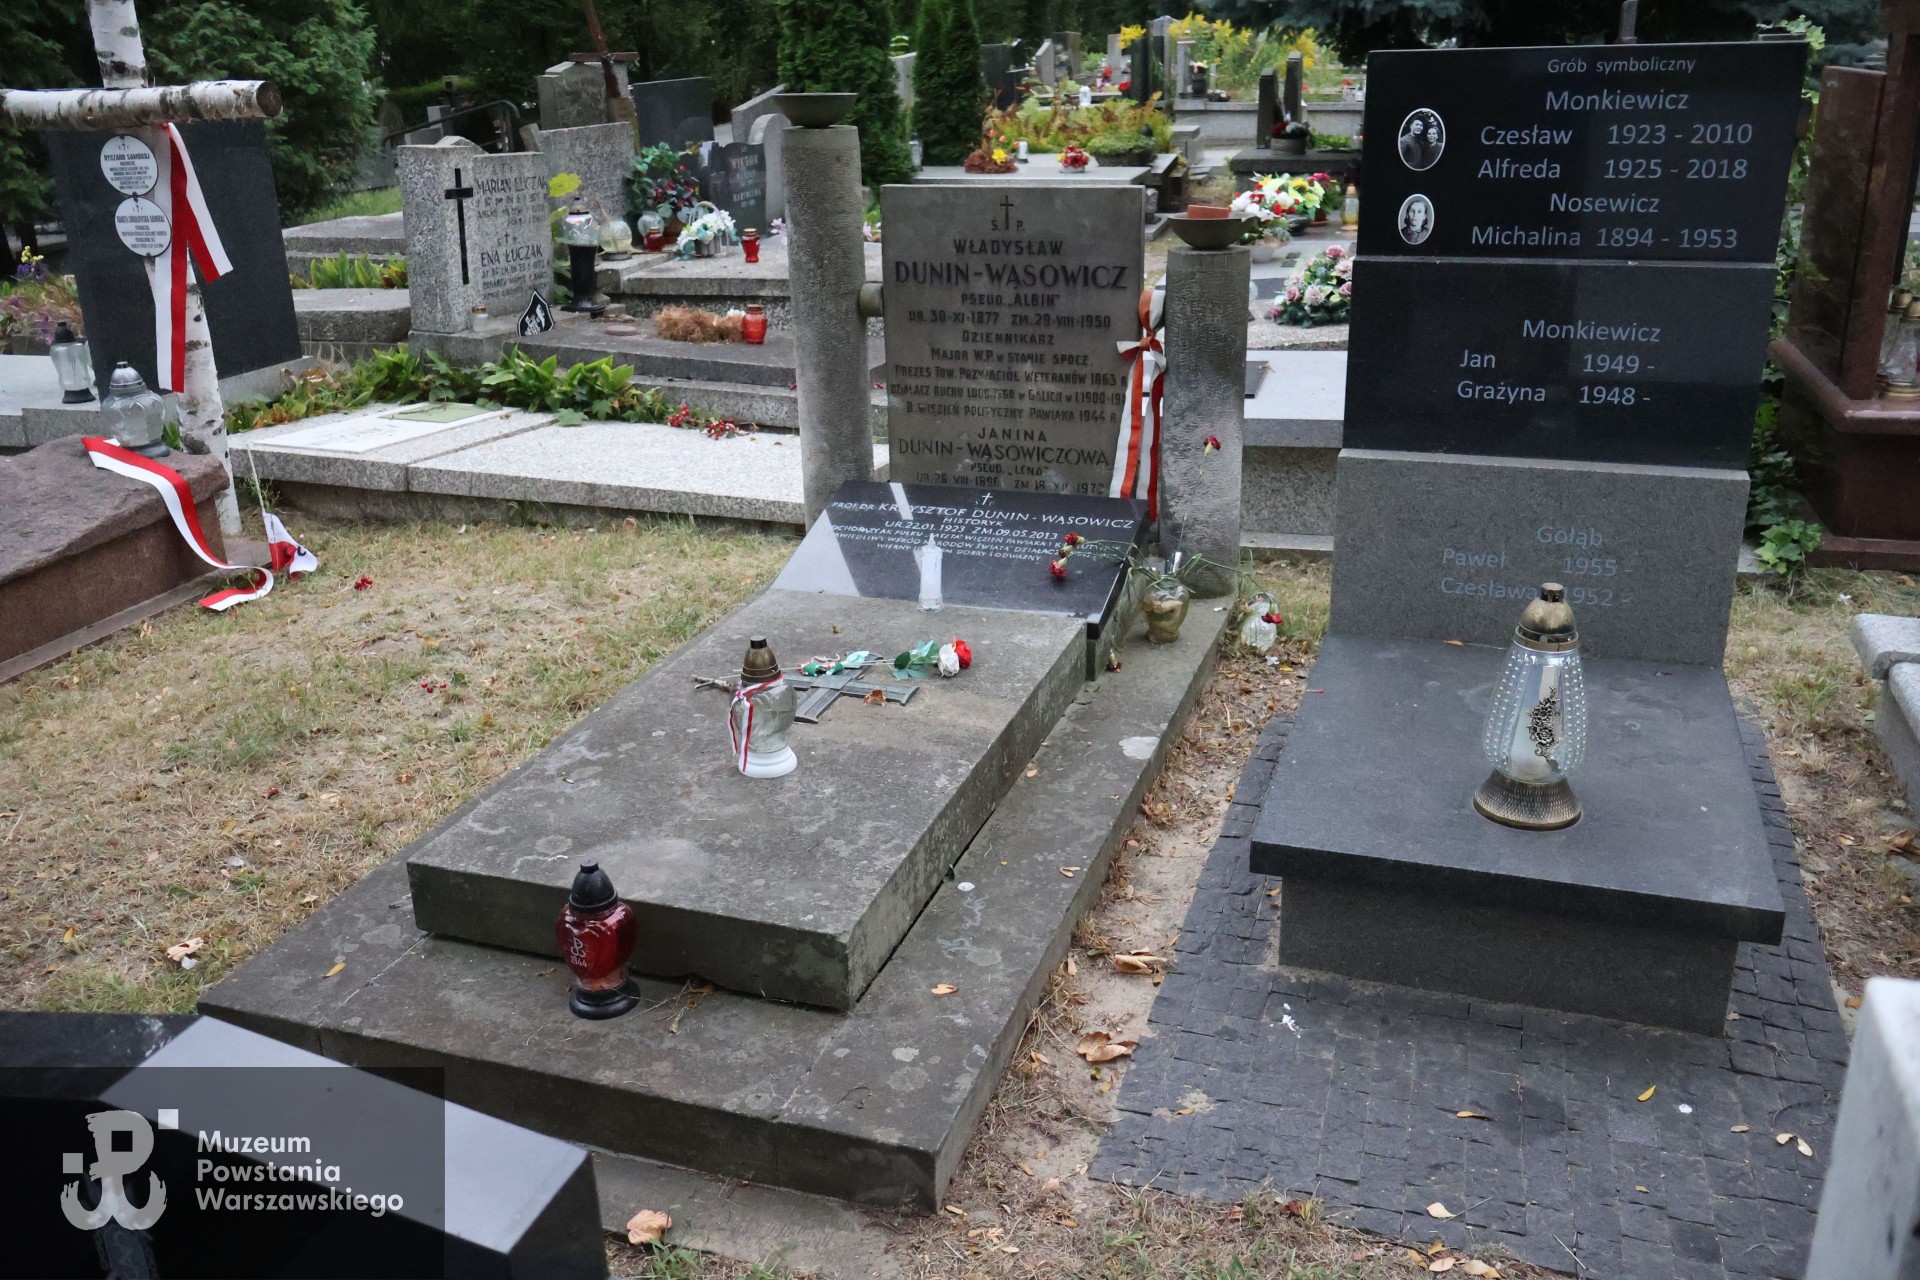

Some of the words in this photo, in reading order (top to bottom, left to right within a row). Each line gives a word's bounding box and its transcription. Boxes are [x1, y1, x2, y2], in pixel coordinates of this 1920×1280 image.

[1547, 57, 1587, 74] Grób
[1596, 57, 1696, 76] symboliczny
[1545, 89, 1690, 112] Monkiewicz
[1480, 125, 1573, 146] Czesław
[1607, 124, 1666, 146] 1923
[1690, 122, 1753, 145] 2010
[1477, 157, 1561, 179] Alfreda
[1604, 158, 1662, 179] 1925
[1686, 157, 1748, 179] 2018
[1549, 192, 1660, 213] Nosewicz
[1471, 225, 1581, 247] Michalina
[1596, 227, 1654, 248] 1894
[1679, 227, 1738, 248] 1953
[954, 239, 1063, 256] WŁADYSŁAW
[962, 330, 1055, 345] DZIENNIKARZ
[1522, 318, 1661, 343] Monkiewicz
[1459, 349, 1496, 368] Jan
[1583, 353, 1640, 374] 1949
[1090, 372, 1117, 386] 1863
[1457, 381, 1546, 405] Grażyna
[1578, 385, 1636, 406] 1948
[1080, 410, 1106, 422] 1944
[978, 428, 1048, 442] JANINA
[879, 502, 967, 516] KRYSZTOF
[972, 509, 1030, 521] DUNIN
[943, 517, 1004, 526] HISTORYK
[923, 540, 974, 549] NRODÓW
[1537, 525, 1603, 550] Gołąb
[1442, 547, 1506, 569] Paweł
[1561, 556, 1617, 576] 1955
[1440, 576, 1541, 600] Czesława
[1563, 586, 1613, 607] 1952
